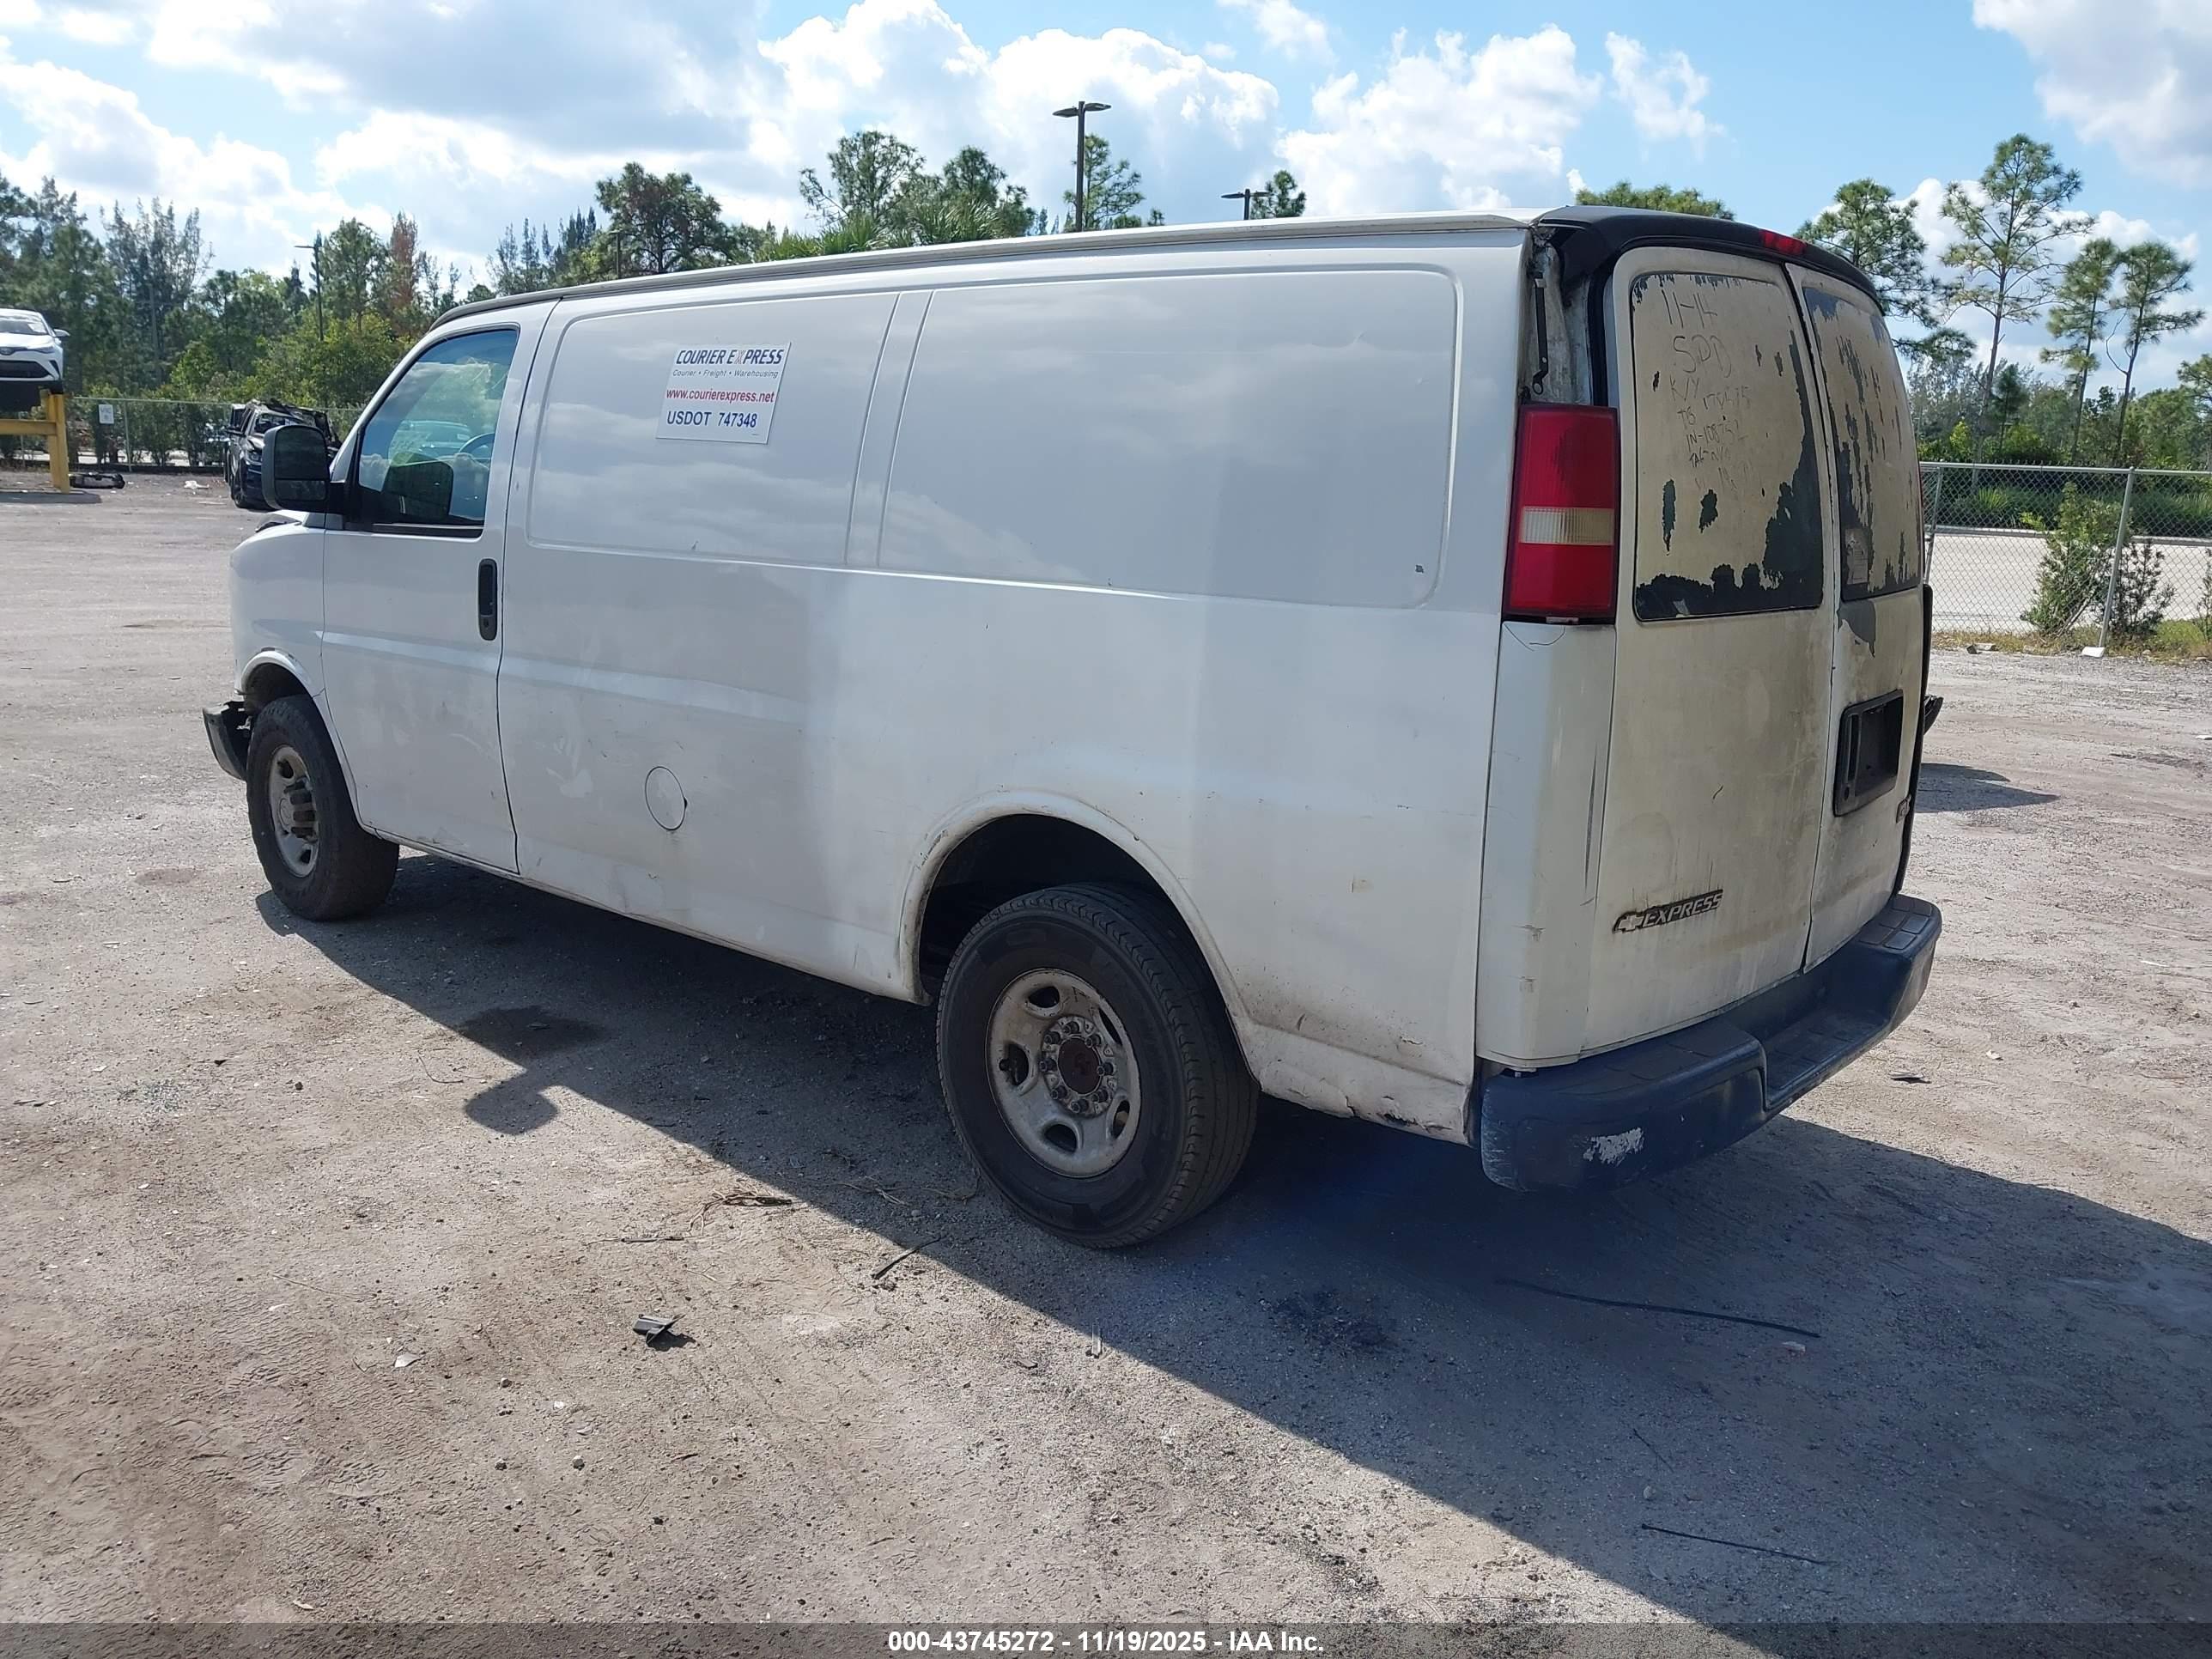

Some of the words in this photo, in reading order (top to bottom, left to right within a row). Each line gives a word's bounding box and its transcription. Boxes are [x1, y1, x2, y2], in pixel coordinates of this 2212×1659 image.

[1661, 289, 1718, 328] 11-14
[676, 349, 726, 365] COURIER
[726, 349, 784, 365] EXPRESS
[702, 369, 727, 379] Freight
[734, 370, 779, 379] Warehousing
[666, 388, 775, 404] www.courierexpress.net
[666, 410, 712, 426] USDOT
[717, 412, 757, 428] 747348
[1642, 892, 1723, 927] EXPRESS
